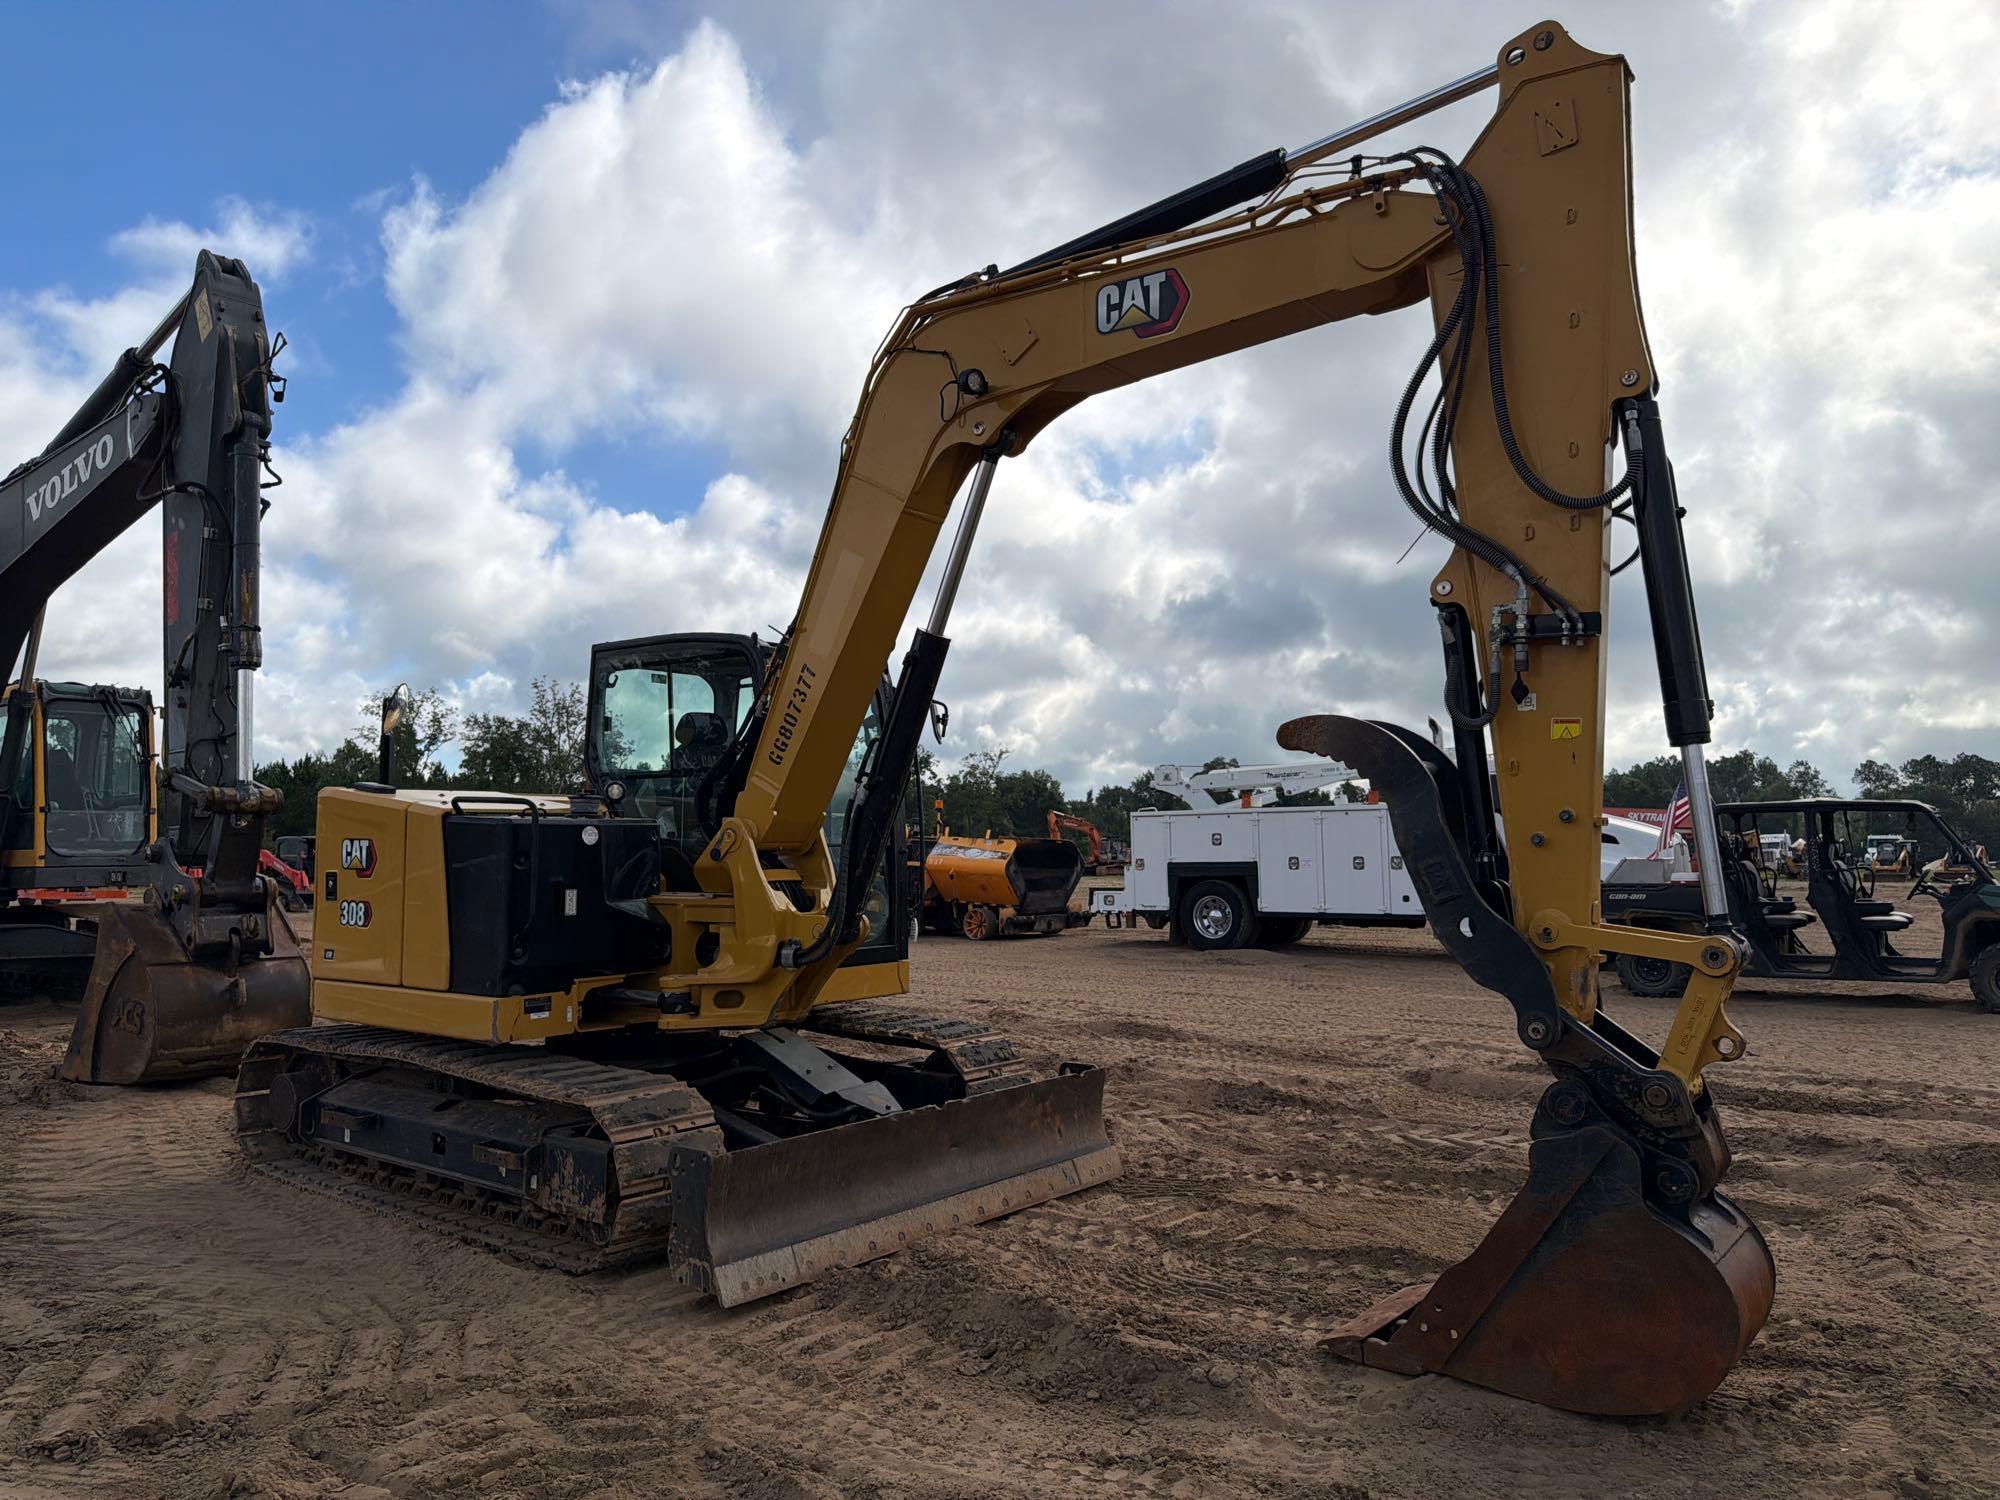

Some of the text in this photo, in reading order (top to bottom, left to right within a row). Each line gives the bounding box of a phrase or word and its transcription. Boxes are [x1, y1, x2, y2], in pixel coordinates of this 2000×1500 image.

[1097, 271, 1167, 334] CAT
[26, 433, 114, 521] VOLVO
[768, 663, 816, 766] GG807377
[342, 839, 369, 869] CAT
[340, 901, 365, 926] 308
